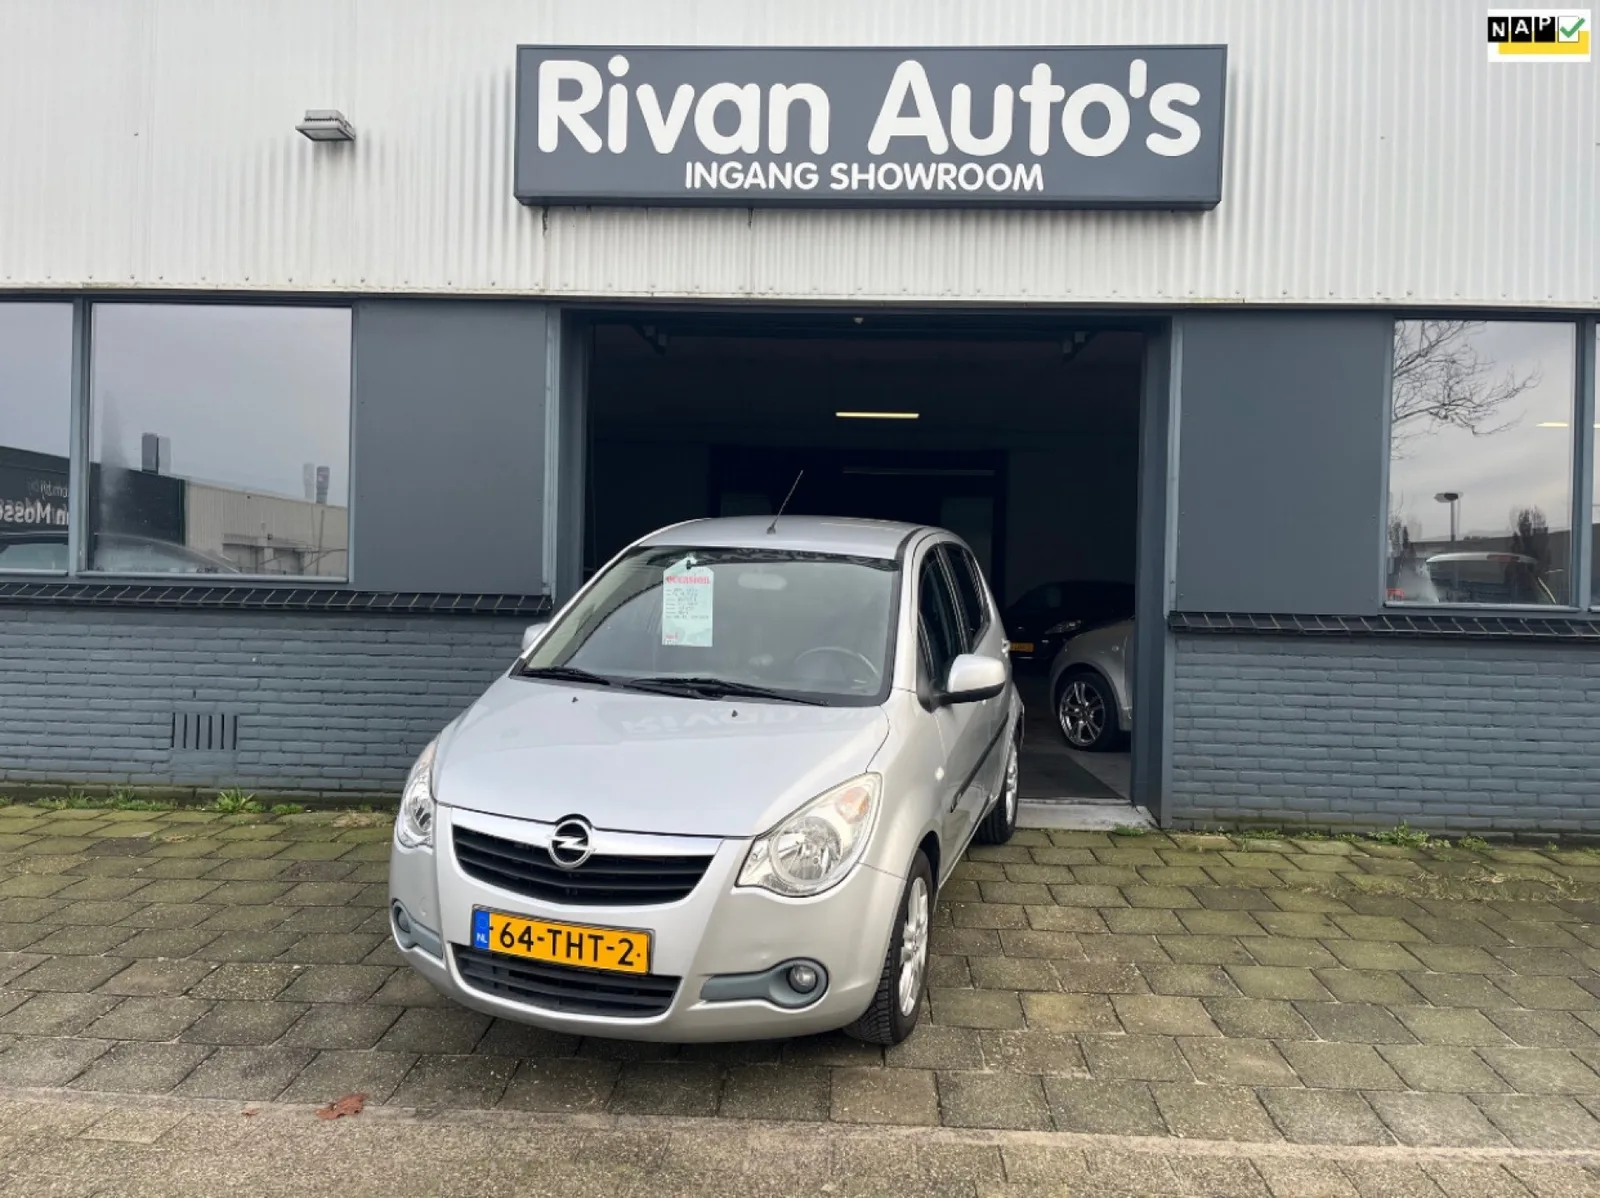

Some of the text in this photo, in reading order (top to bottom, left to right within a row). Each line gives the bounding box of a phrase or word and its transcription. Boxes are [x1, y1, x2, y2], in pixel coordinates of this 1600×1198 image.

[538, 55, 1201, 157] Rivan Auto's
[685, 161, 1044, 192] INGANG SHOWROOM
[476, 933, 488, 944] NL
[500, 922, 634, 966] 64-THT-2
